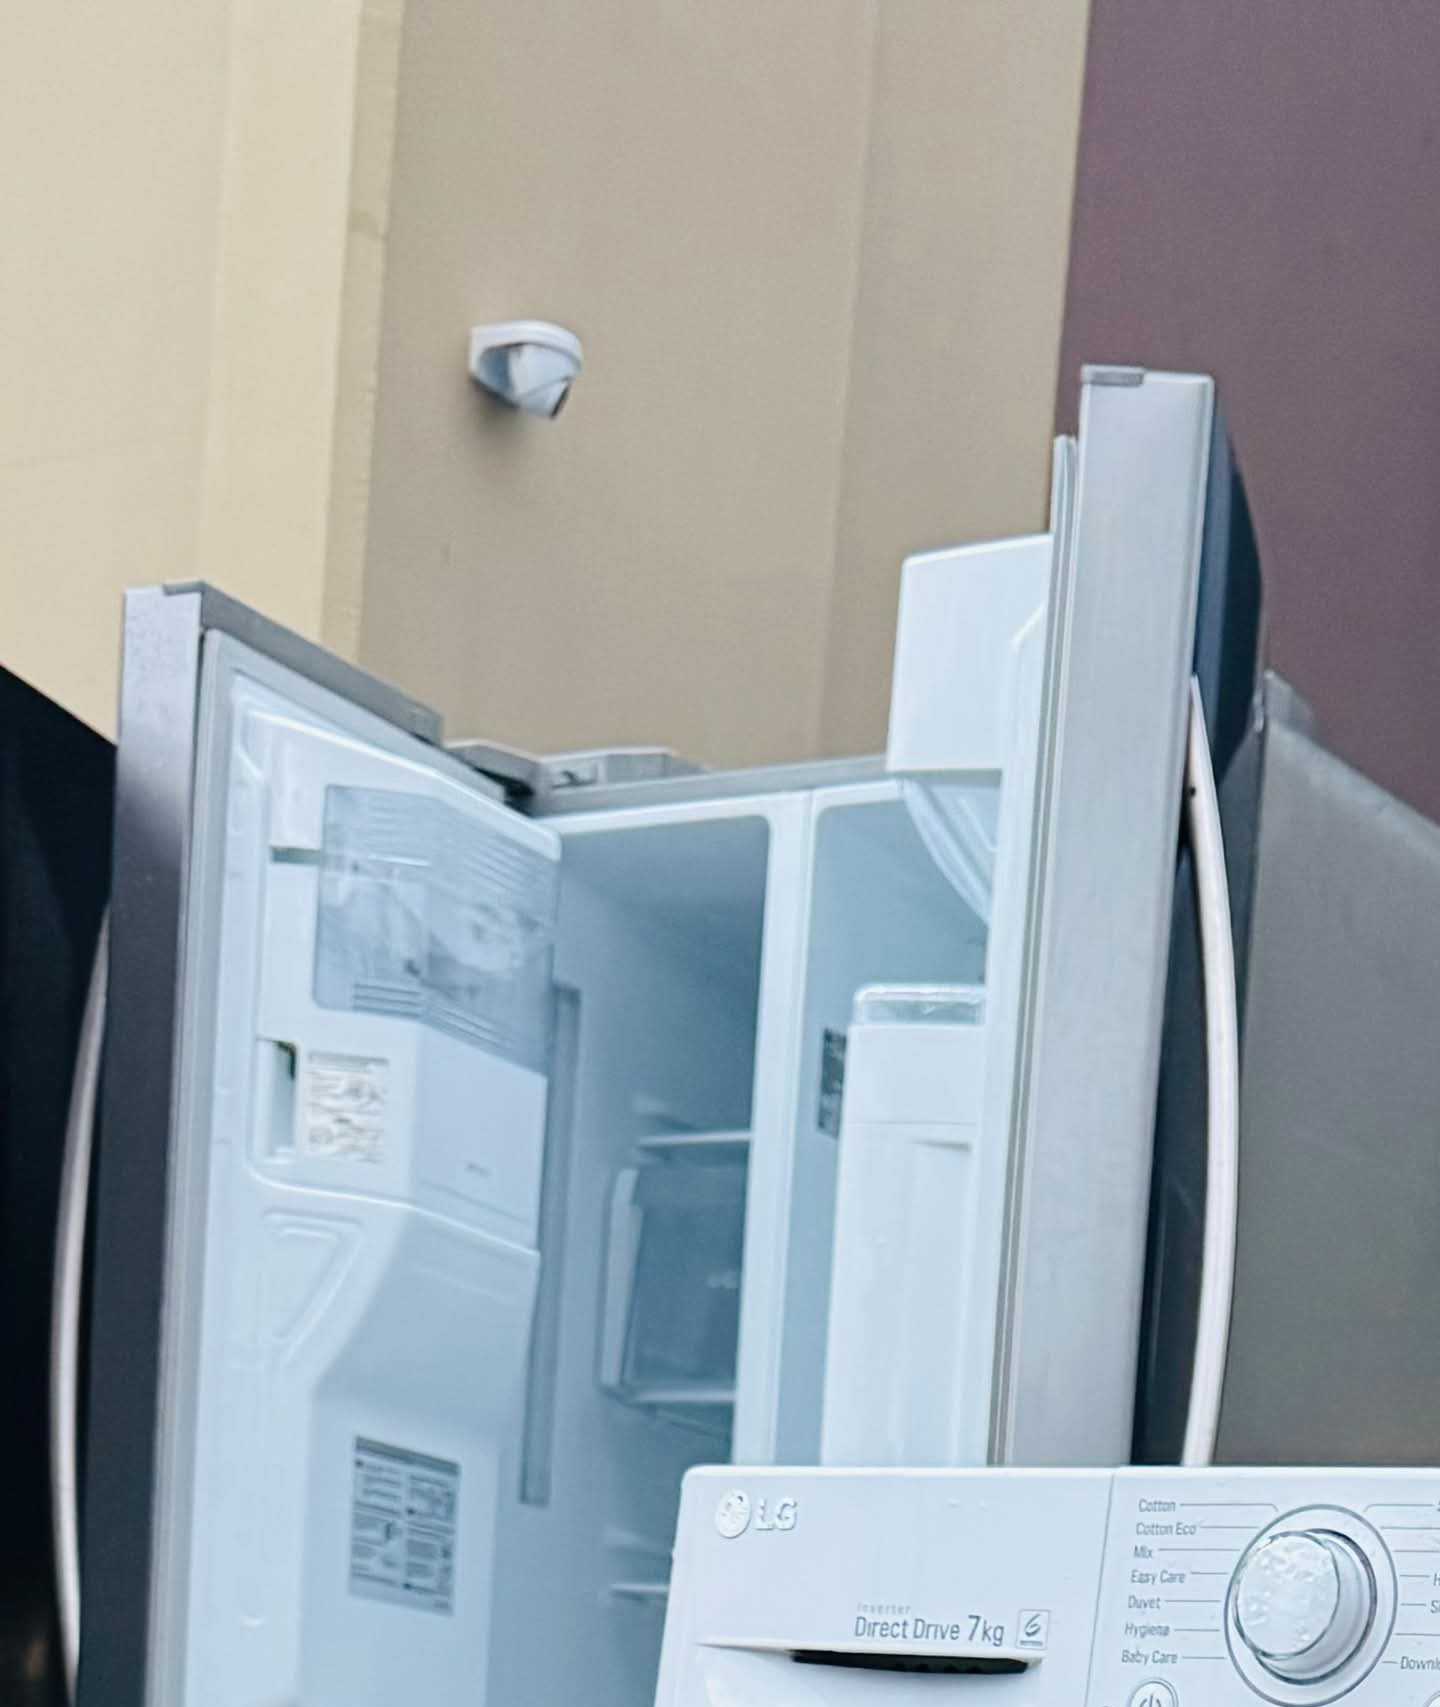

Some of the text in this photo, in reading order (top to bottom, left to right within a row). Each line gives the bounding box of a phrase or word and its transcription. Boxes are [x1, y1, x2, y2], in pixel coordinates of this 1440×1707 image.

[1138, 1500, 1176, 1512] Cotton
[756, 1498, 798, 1531] LG
[1136, 1522, 1197, 1536] Cotton Eco
[1134, 1546, 1153, 1558] Mix
[1131, 1570, 1186, 1585] Easy Care
[1128, 1596, 1161, 1609] Duvet
[855, 1615, 1005, 1647] Direct Drive 7kg
[1125, 1623, 1170, 1638] Hygiene
[1121, 1650, 1178, 1666] Baby Care
